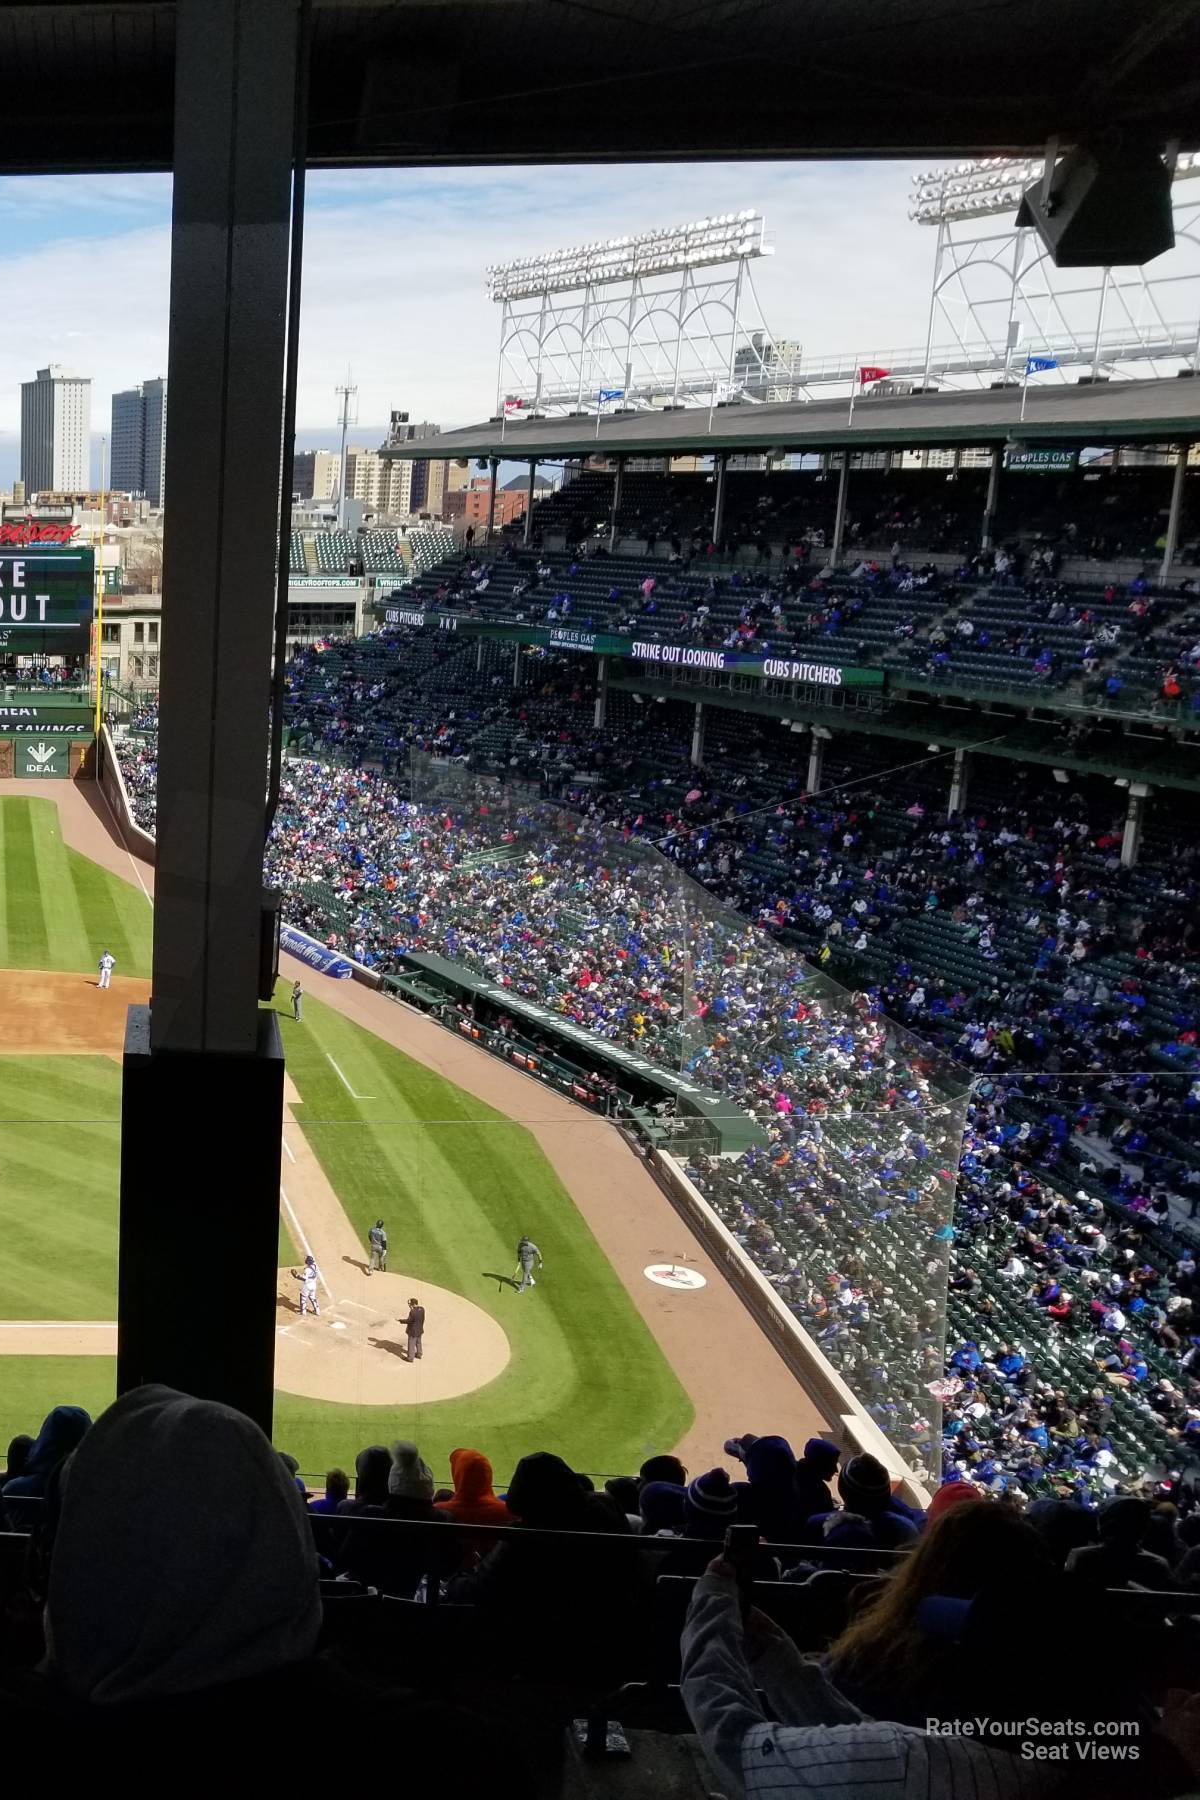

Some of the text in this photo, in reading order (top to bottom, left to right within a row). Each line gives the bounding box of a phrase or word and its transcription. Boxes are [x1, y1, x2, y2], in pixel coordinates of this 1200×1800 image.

[1010, 452, 1071, 462] PEOPLES GAS
[386, 610, 424, 626] CUBS PITCHERS
[550, 630, 595, 644] PEOPLES GAS
[632, 642, 724, 669] STRIKE OUT LOOKING
[763, 658, 842, 686] CUBS PITCHERS
[26, 764, 58, 772] IDEAL
[302, 946, 322, 965] Wrap
